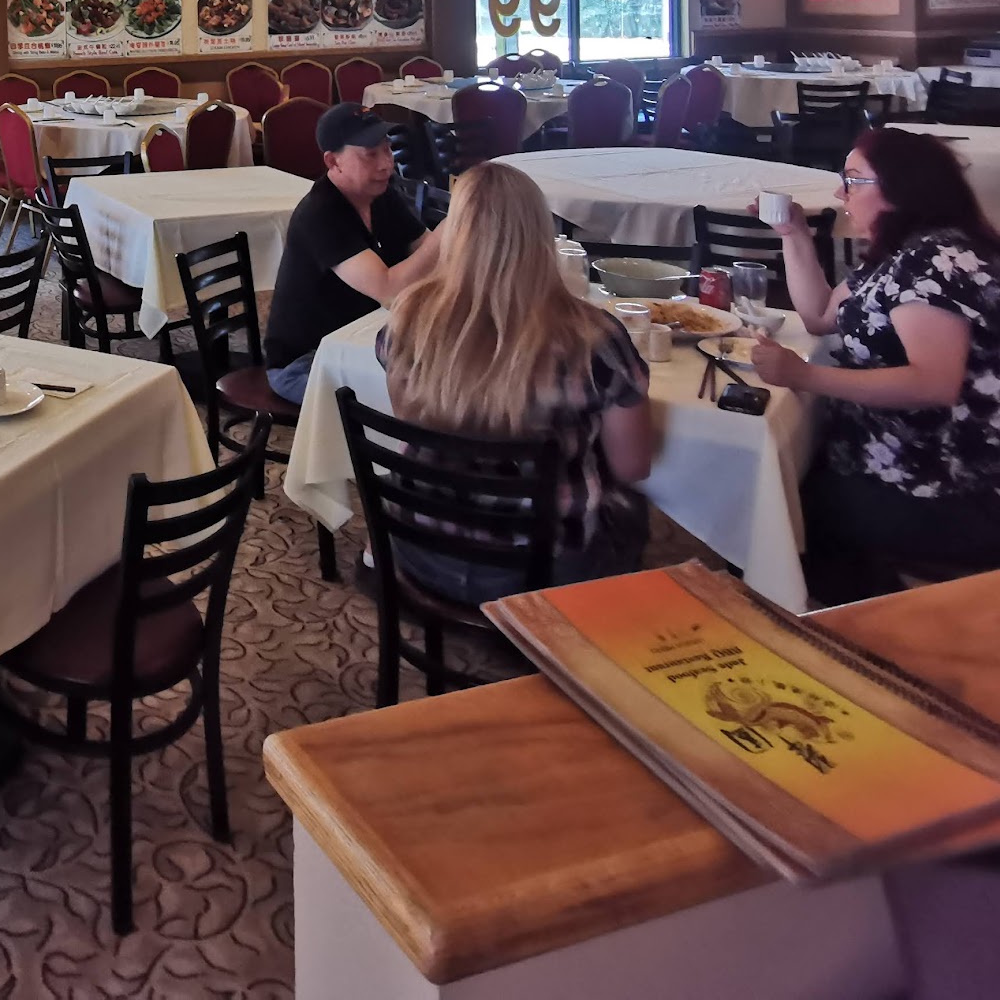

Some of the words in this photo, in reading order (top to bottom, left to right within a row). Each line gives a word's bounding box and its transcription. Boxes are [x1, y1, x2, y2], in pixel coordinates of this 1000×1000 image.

[644, 653, 713, 673] Restaurant
[718, 659, 747, 670] Jade
[667, 667, 718, 684] Seafood
